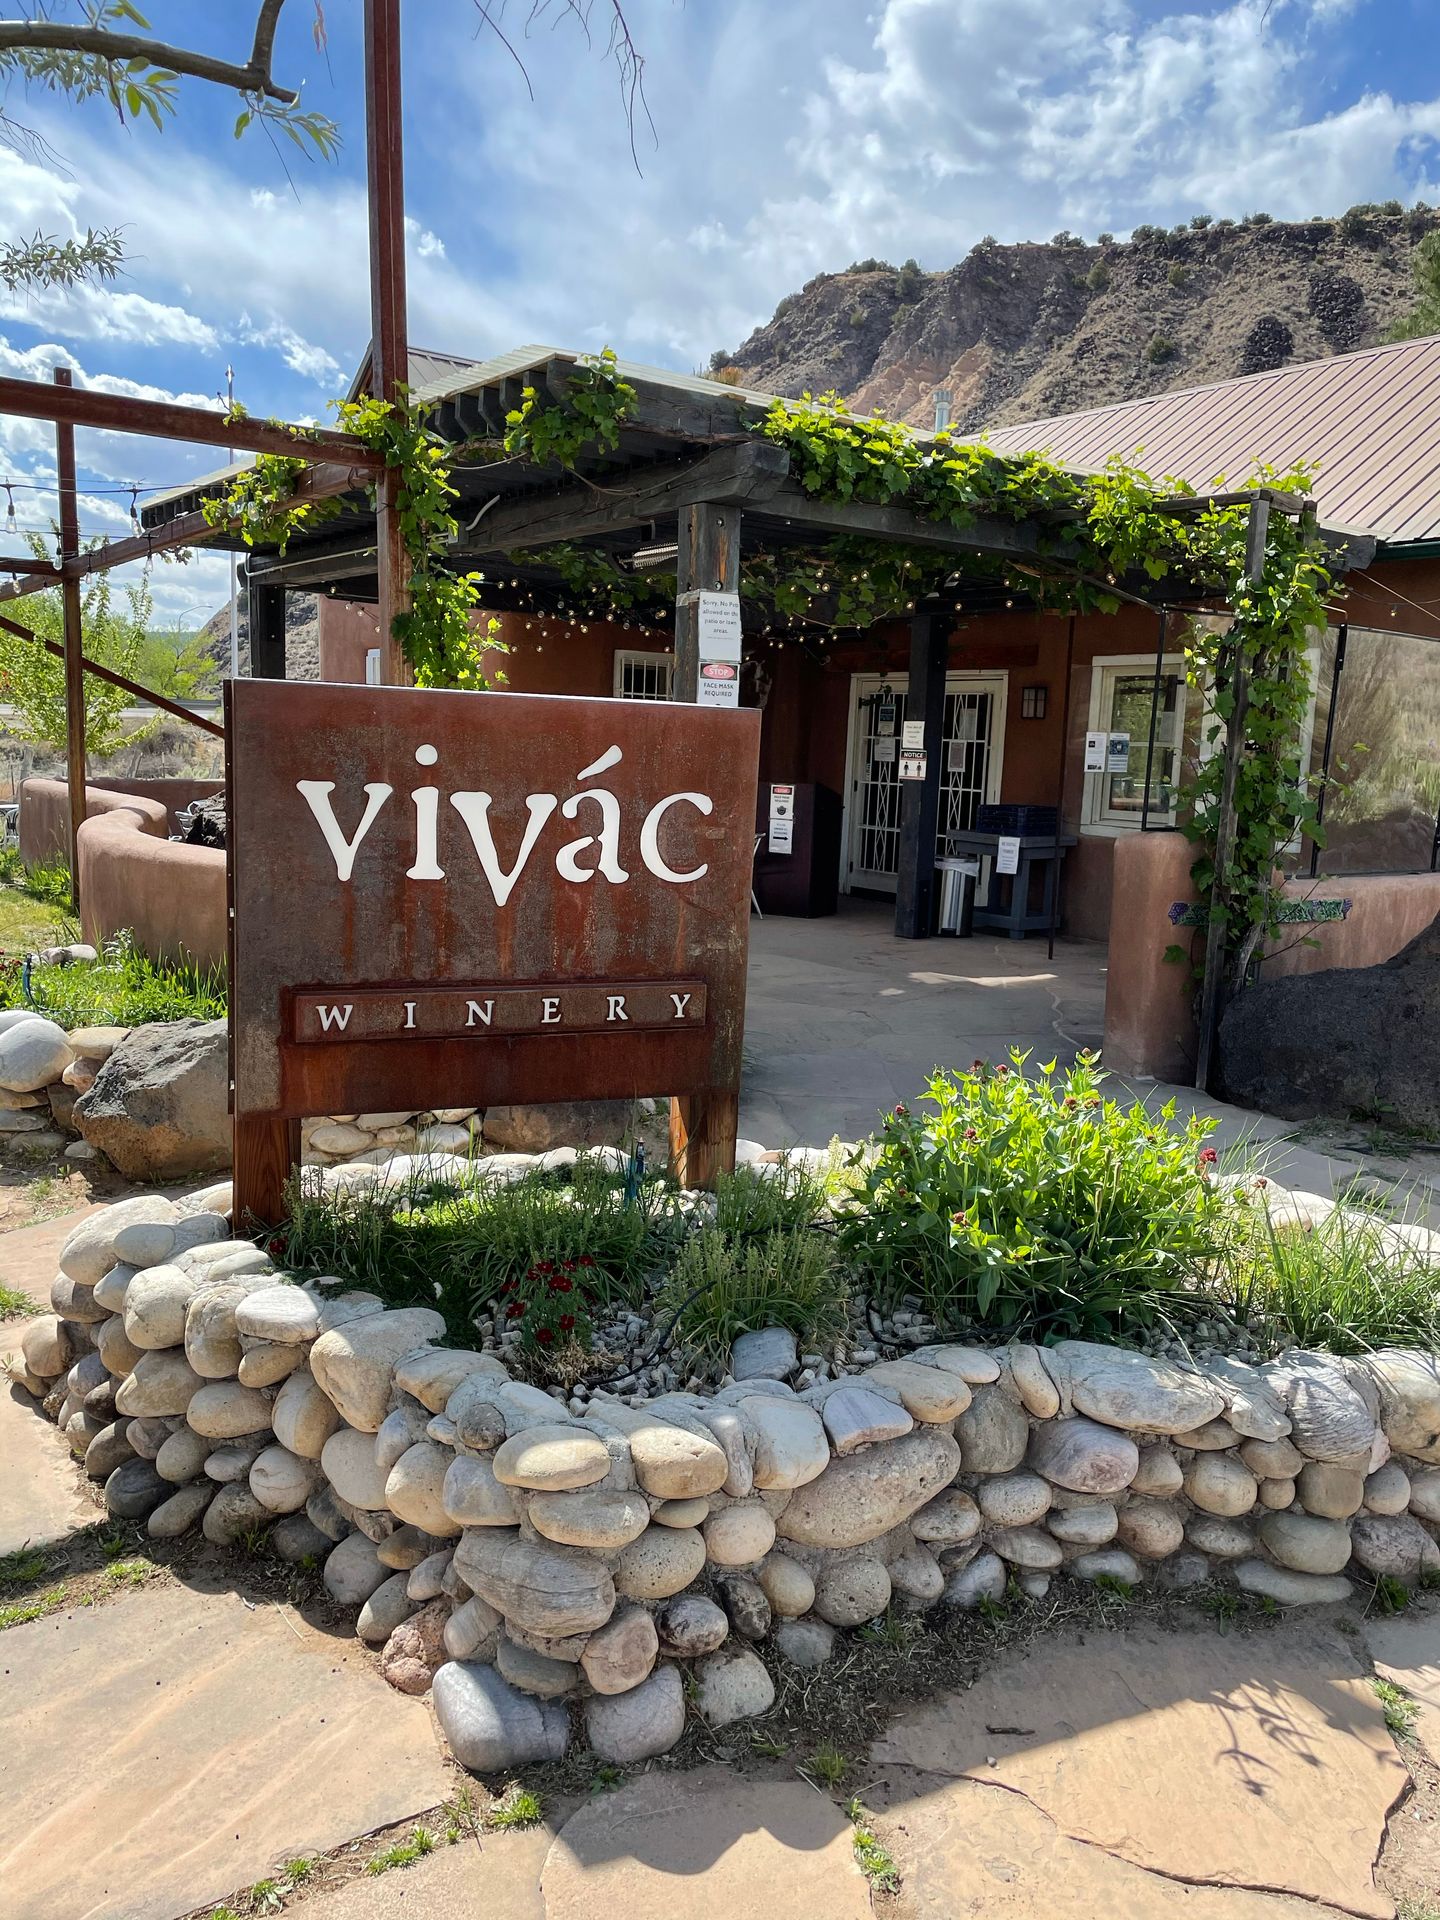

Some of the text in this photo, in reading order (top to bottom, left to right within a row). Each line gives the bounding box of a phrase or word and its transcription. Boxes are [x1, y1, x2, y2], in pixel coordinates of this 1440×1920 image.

[704, 690, 733, 698] REQUIRED
[296, 744, 713, 906] vivác
[316, 993, 692, 1031] WINERY
